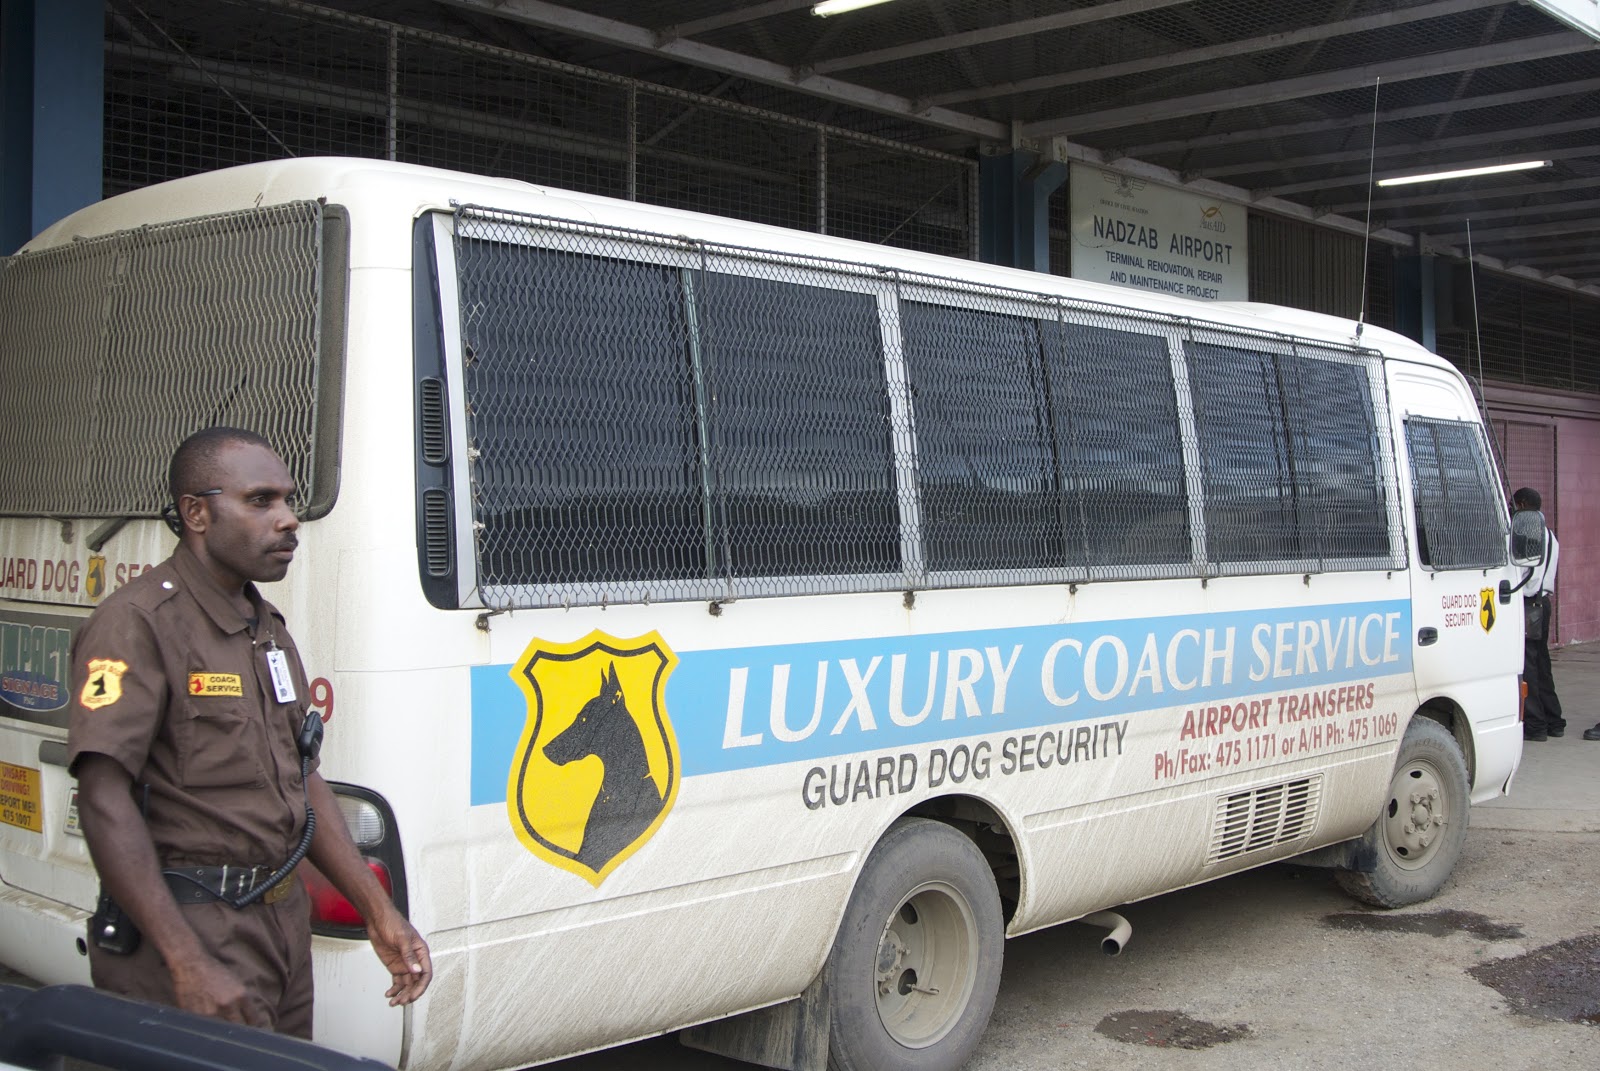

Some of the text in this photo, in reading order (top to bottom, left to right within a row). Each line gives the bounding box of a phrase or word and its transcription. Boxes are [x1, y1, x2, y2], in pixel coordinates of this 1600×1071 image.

[1094, 215, 1232, 265] NADZAB AIRPORT
[1106, 251, 1223, 284] TERMINAL RENOVATION, REPAIR
[1110, 271, 1219, 299] AND MAINTENANCE PROJECT
[42, 559, 80, 593] DOG
[1442, 594, 1477, 609] GUARD DOG
[1445, 612, 1474, 628] SECURITY
[2, 676, 58, 700] SIGNAGE
[206, 685, 242, 693] SERVICE
[210, 676, 236, 684] COACH
[722, 612, 1401, 749] LUXURY COACH SERVICE
[309, 677, 334, 724] 9
[1180, 682, 1375, 741] AIRPORT TRANSFERS
[1154, 712, 1398, 780] Ph/Fax: 475 1171 or A/H Ph: 475 1069
[3, 766, 27, 782] UNSAFE
[802, 720, 1129, 811] GUARD DOG SECURITY
